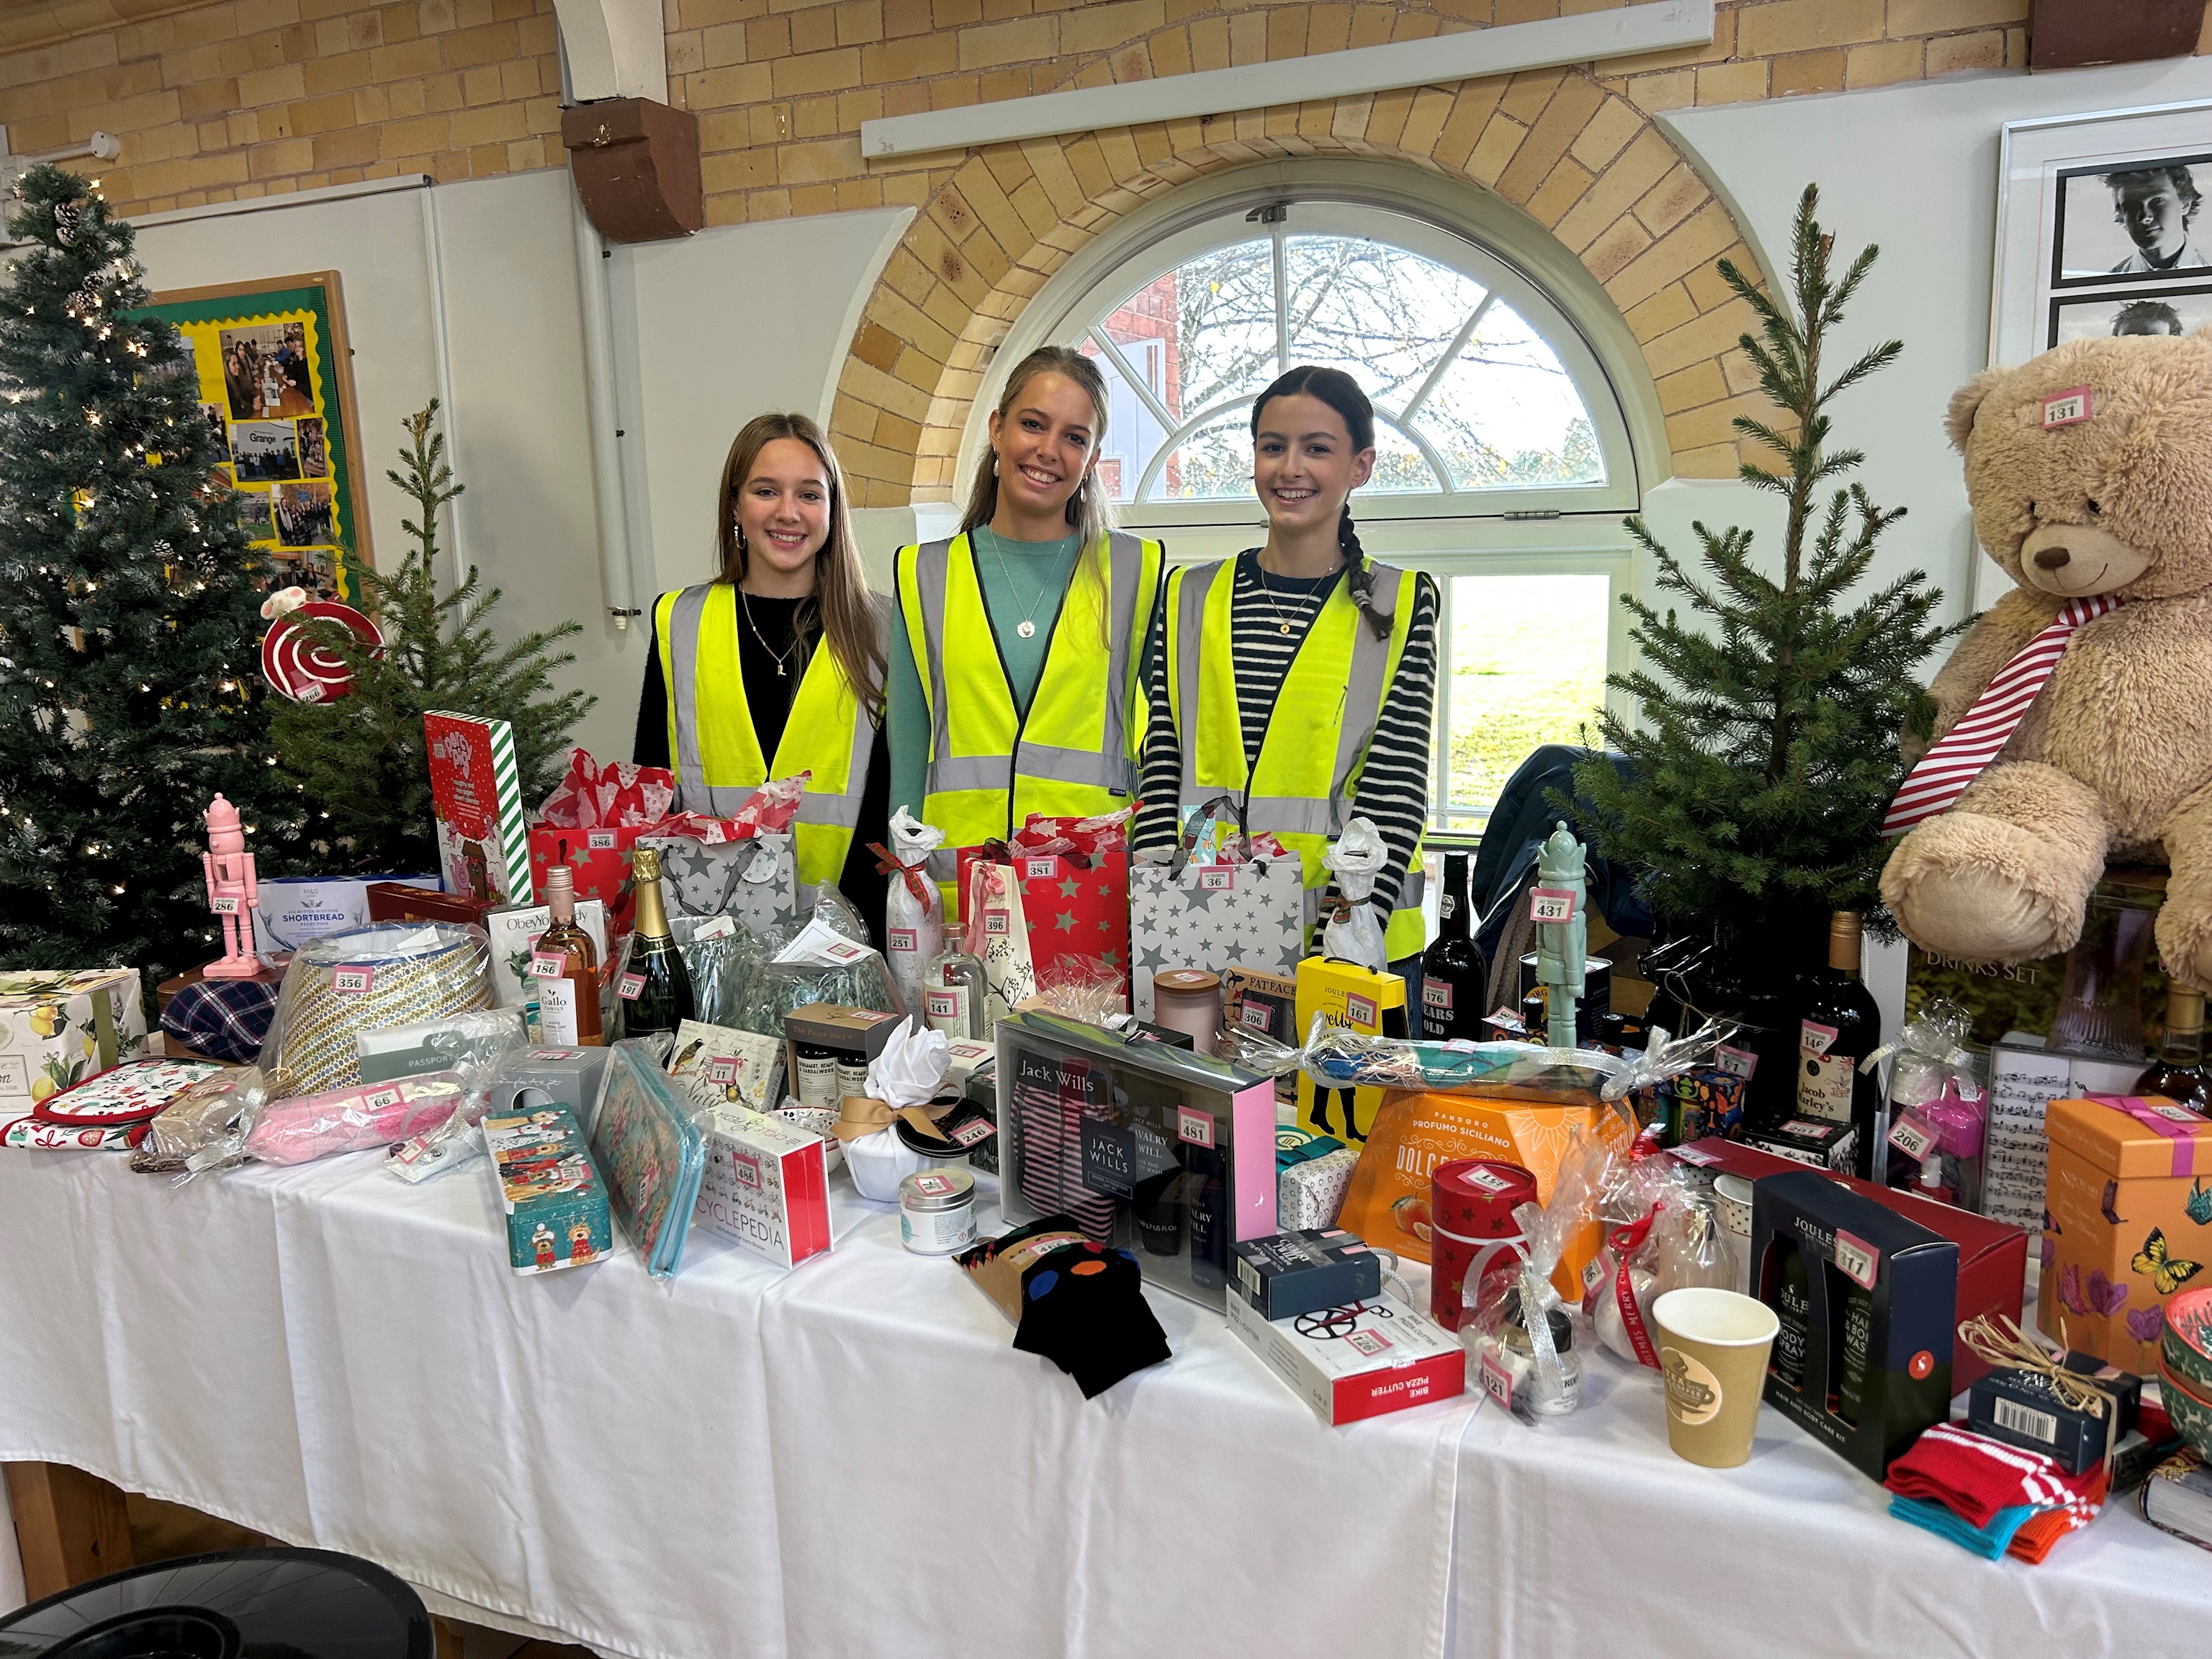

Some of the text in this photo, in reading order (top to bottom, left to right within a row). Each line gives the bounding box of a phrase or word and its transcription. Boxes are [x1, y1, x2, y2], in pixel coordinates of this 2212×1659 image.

[2049, 405, 2074, 421] 131
[250, 433, 276, 444] Grange
[444, 732, 472, 760] percy
[452, 748, 469, 780] pig
[1030, 867, 1048, 876] 381
[1208, 878, 1221, 886] 36
[215, 902, 233, 911] 286
[1537, 905, 1562, 917] 431
[987, 921, 1003, 930] 396
[536, 965, 555, 974] 186
[2002, 963, 2040, 984] SET
[338, 979, 361, 988] 356
[621, 985, 636, 995] 191
[1324, 986, 1349, 998] JOULES
[1426, 992, 1443, 1003] 176
[541, 997, 567, 1006] Gallo
[931, 1004, 947, 1013] 141
[1244, 1013, 1262, 1025] 306
[1350, 1008, 1367, 1021] 161
[1422, 1003, 1454, 1021] EARS
[808, 1028, 827, 1039] Fuzzy
[830, 1032, 848, 1040] Duck
[1424, 1020, 1444, 1035] OLD
[716, 1071, 725, 1079] 11
[1020, 1060, 1094, 1092] Jack Wills
[1802, 1082, 1825, 1099] Jacob
[374, 1097, 390, 1107] 66
[1146, 1120, 1161, 1129] WILLS
[1434, 1112, 1488, 1128] PANDORO
[963, 1129, 986, 1143] 246
[1183, 1125, 1203, 1141] 481
[1413, 1120, 1510, 1148] PROFUMO SICILIANO
[1894, 1130, 1919, 1151] 206
[1092, 1138, 1123, 1159] JACK
[1089, 1149, 1128, 1173] WILLS
[738, 1169, 754, 1182] 486
[696, 1195, 784, 1251] CYCLEPEDIA
[1794, 1217, 1837, 1247] JOULES
[1273, 1244, 1298, 1262] TWILL
[1280, 1238, 1310, 1262] CAVALRY
[1840, 1251, 1863, 1275] 311
[1230, 1302, 1240, 1316] BIKE
[1621, 1290, 1638, 1326] MERRY
[1407, 1314, 1424, 1326] BIKE
[1242, 1323, 1259, 1341] CUTTER
[1398, 1317, 1438, 1346] PIZZA CUTTER
[1352, 1336, 1375, 1351] 126
[1665, 1368, 1684, 1385] TEA
[1371, 1375, 1429, 1397] PIZZA CUTTER
[1409, 1385, 1429, 1398] BIKE
[1485, 1375, 1502, 1397] 121
[1672, 1382, 1701, 1397] COFFEE
[1775, 1390, 1845, 1442] HAIR AND BODY CARE KIT
